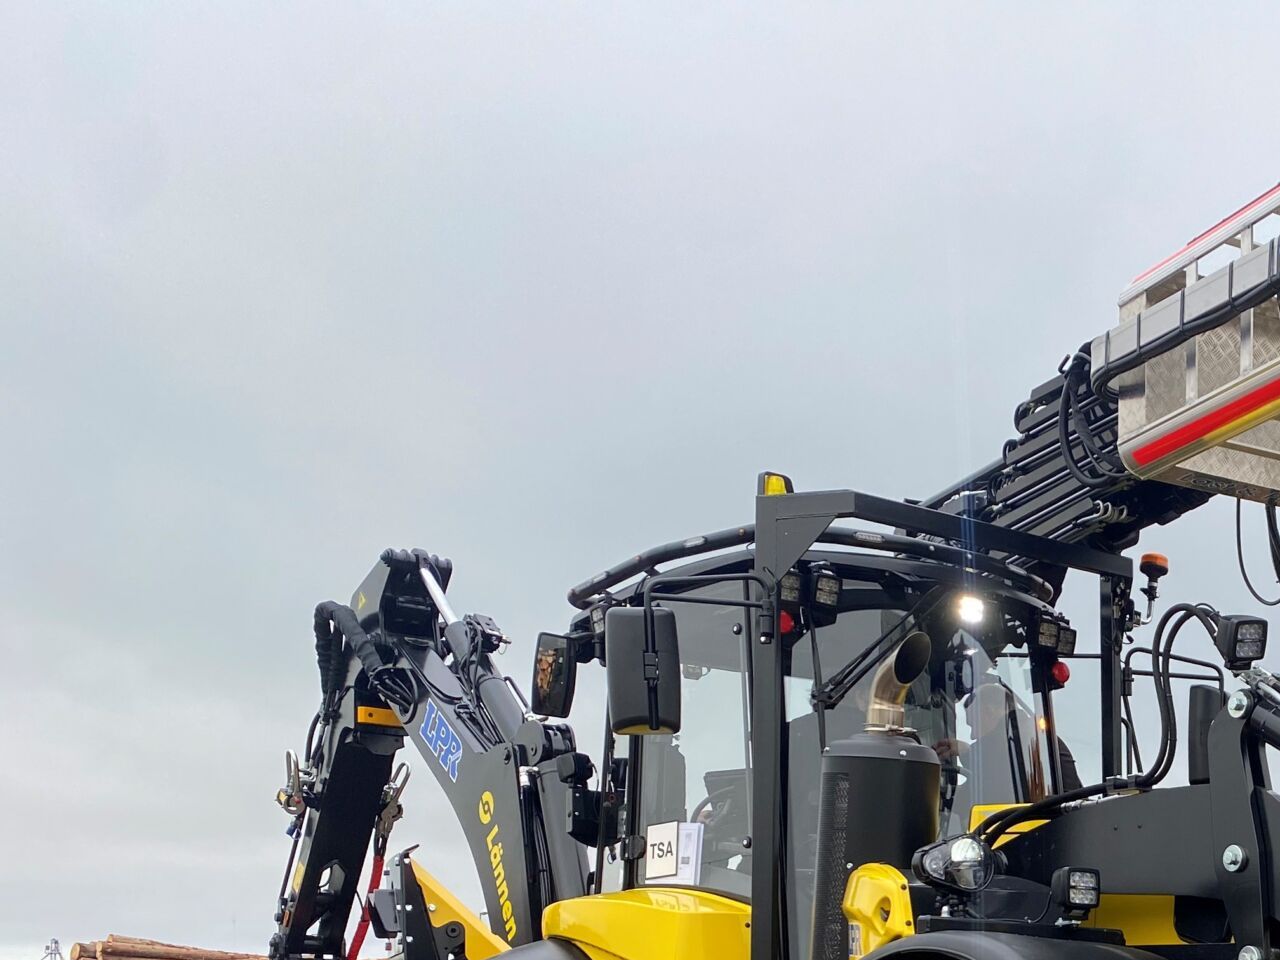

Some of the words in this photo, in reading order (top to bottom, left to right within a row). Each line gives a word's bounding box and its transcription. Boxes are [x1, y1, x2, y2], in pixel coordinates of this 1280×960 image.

[419, 697, 463, 783] LPR
[486, 824, 517, 942] Lännen
[650, 841, 673, 859] TSA
